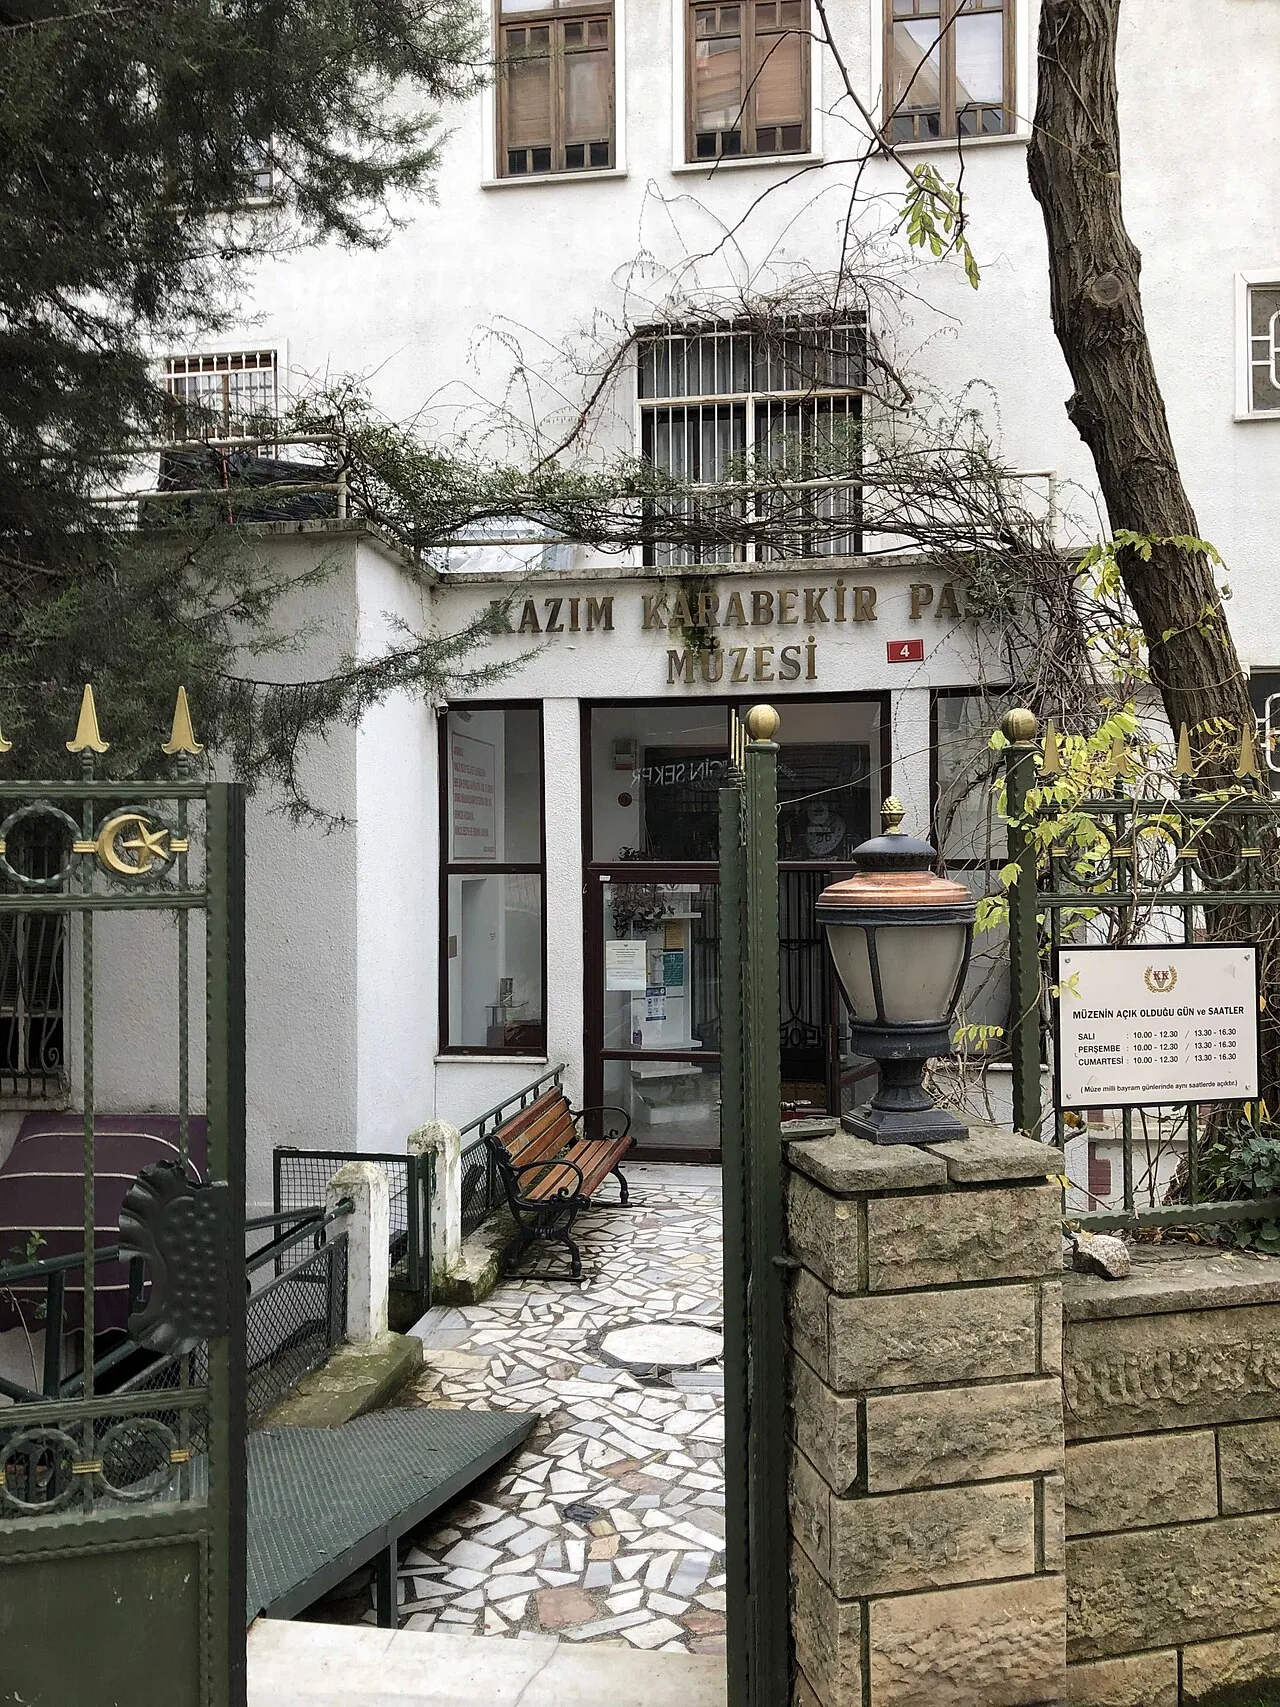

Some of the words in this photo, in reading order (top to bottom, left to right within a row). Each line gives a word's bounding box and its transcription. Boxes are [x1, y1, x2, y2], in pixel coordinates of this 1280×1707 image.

[490, 596, 615, 634] KAZIM
[641, 578, 878, 629] KARABEKİR
[900, 645, 910, 657] 4
[666, 635, 818, 684] MÜZESİ
[1072, 1008, 1114, 1019] MÜZENİN
[1116, 1009, 1138, 1020] AÇIK
[1140, 1007, 1175, 1017] OLDUĞU
[1176, 1006, 1195, 1016] GÜN
[1208, 1006, 1244, 1015] SAATLER
[1159, 1030, 1179, 1038] 12.30
[1218, 1028, 1237, 1036] 16.30
[1078, 1045, 1121, 1054] PERŞEMBE
[1218, 1040, 1237, 1048] 16.30
[1078, 1056, 1124, 1066] CUMARTESİ
[1133, 1056, 1153, 1064] 10.00
[1159, 1055, 1179, 1063] 12.30
[1194, 1053, 1212, 1061] 13.30
[1141, 1083, 1174, 1091] günlerinde
